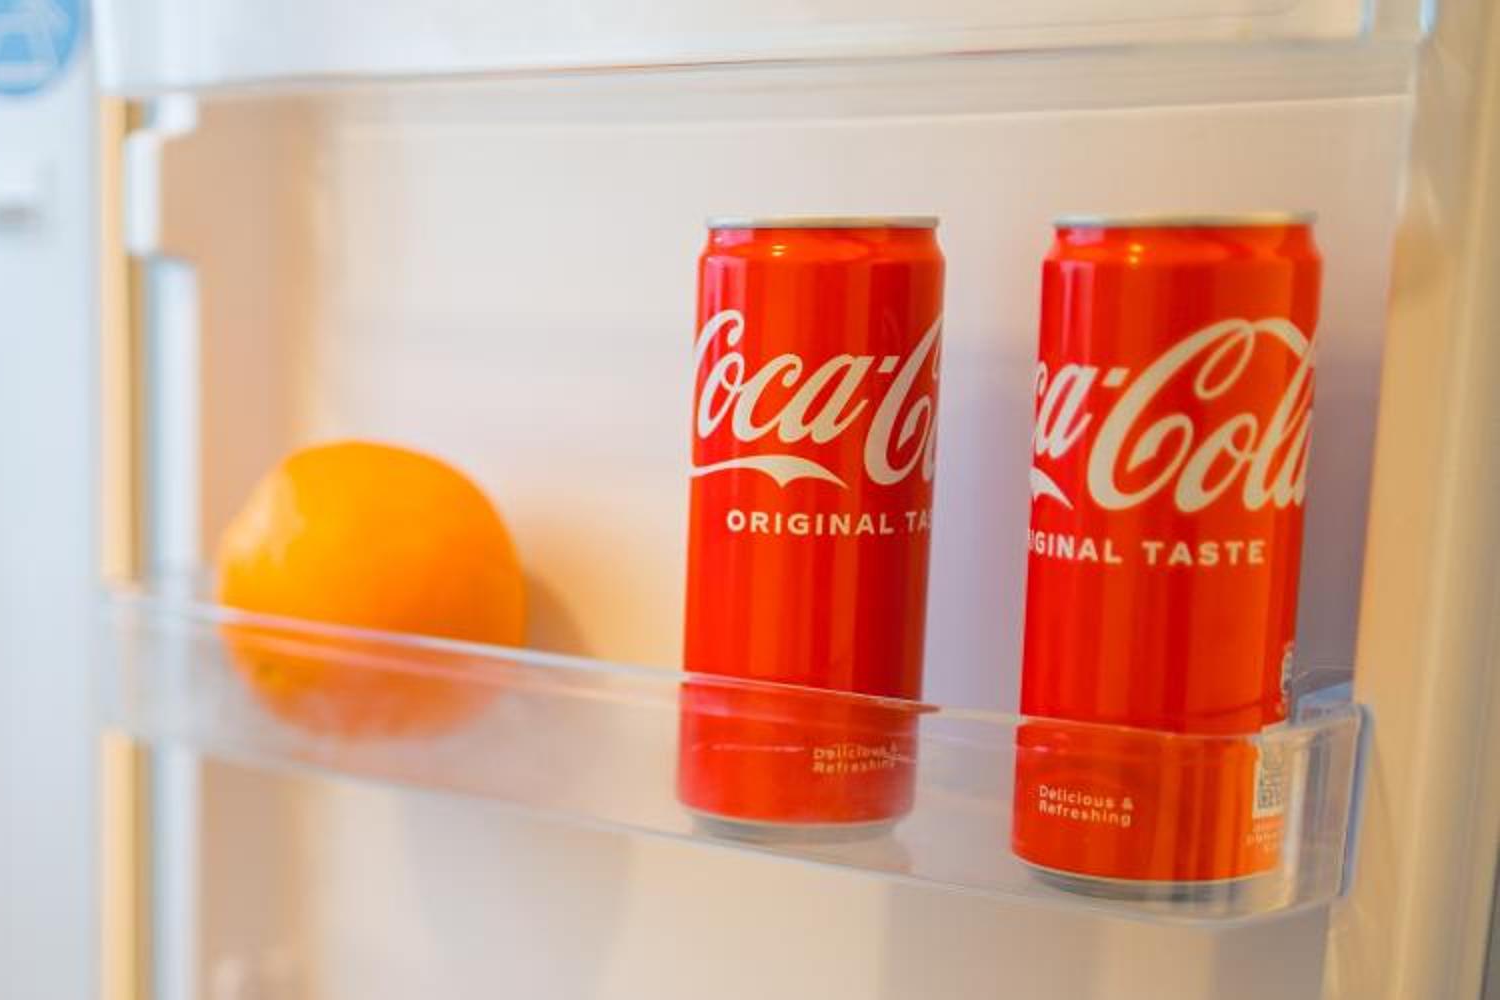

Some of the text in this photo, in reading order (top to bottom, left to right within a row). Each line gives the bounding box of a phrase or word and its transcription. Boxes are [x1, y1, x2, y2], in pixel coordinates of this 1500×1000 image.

[726, 508, 932, 535] ORIGINAL TA
[1142, 540, 1266, 566] TASTE
[1039, 784, 1115, 809] Delicious
[1039, 799, 1132, 828] Refreshing
